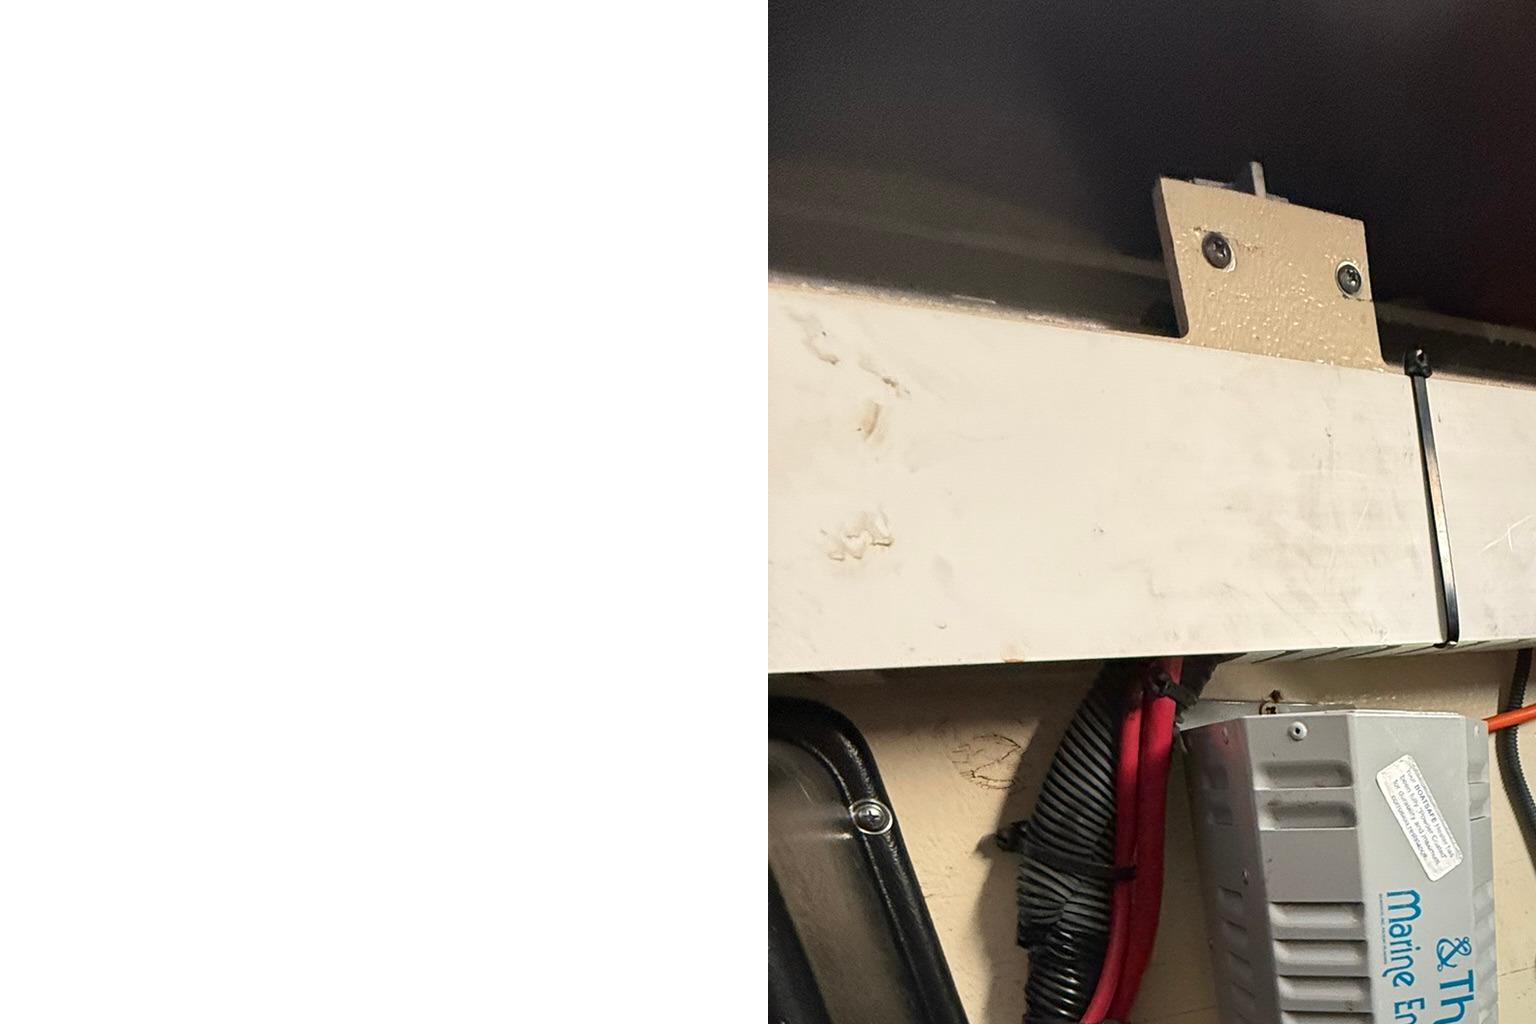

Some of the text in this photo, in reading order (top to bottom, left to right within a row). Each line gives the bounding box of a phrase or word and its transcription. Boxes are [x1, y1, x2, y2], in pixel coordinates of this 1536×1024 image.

[1414, 784, 1437, 823] BOATSAFE
[1414, 821, 1425, 835] and
[1382, 889, 1421, 987] Marine
